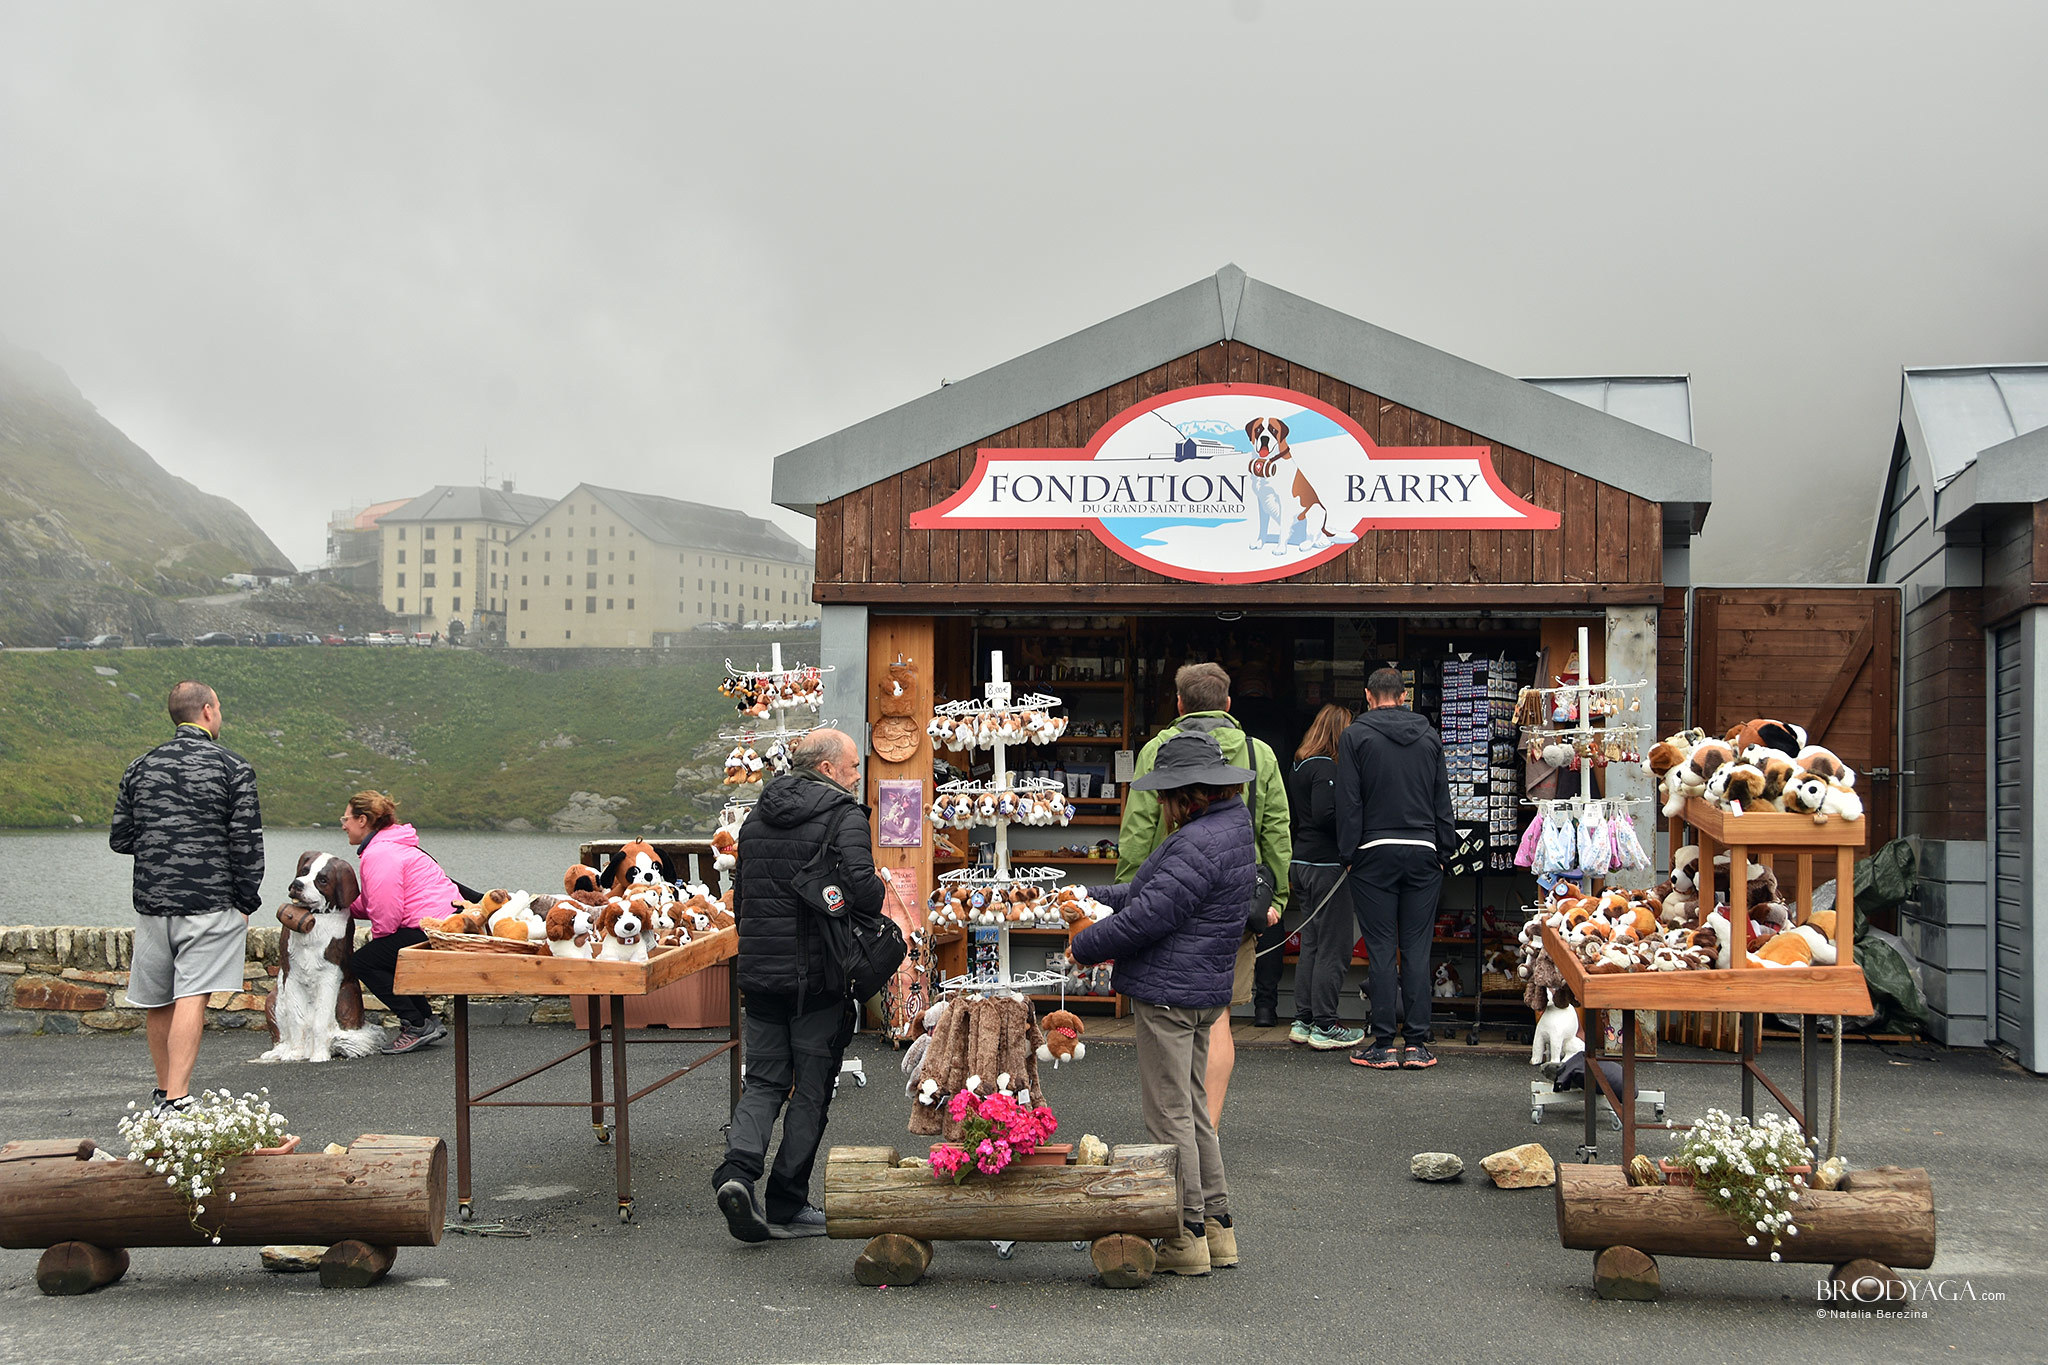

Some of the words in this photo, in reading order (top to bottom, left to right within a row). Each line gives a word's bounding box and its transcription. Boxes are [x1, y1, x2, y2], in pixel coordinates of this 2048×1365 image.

[989, 473, 1247, 503] FONDATION
[1344, 474, 1480, 503] BARRY
[1082, 504, 1101, 514] DU
[1103, 504, 1147, 514] GRAND
[1150, 504, 1186, 514] SAINT
[1188, 504, 1245, 514] BERNARD
